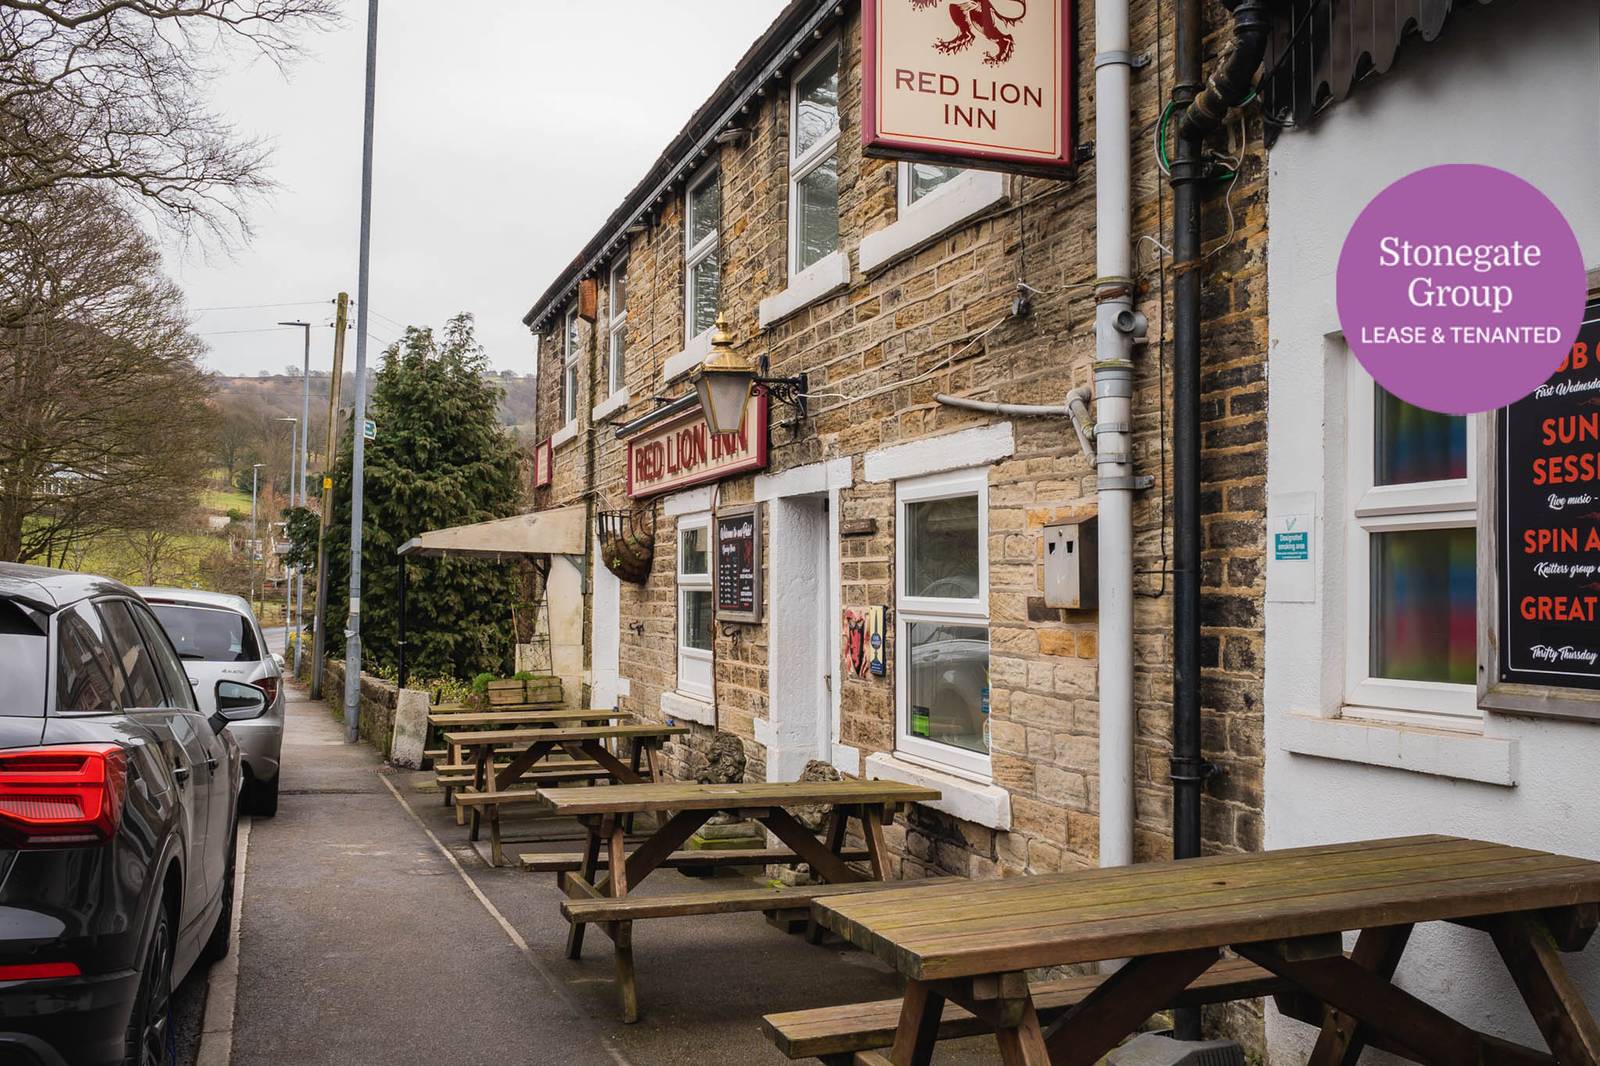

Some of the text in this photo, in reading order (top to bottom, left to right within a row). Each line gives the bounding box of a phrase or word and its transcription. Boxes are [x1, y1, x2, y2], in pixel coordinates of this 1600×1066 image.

[895, 68, 1042, 108] RED LION
[944, 103, 996, 130] INN
[1534, 384, 1554, 399] First
[1542, 412, 1599, 446] SUN
[635, 440, 665, 483] RED
[667, 422, 706, 474] LION
[1547, 493, 1566, 510] Live
[1567, 493, 1592, 505] music
[1523, 527, 1578, 554] SPIN
[1533, 561, 1596, 578] Knitters group
[1520, 595, 1598, 621] GREAT
[1530, 644, 1599, 665] Thrifty Thursday
